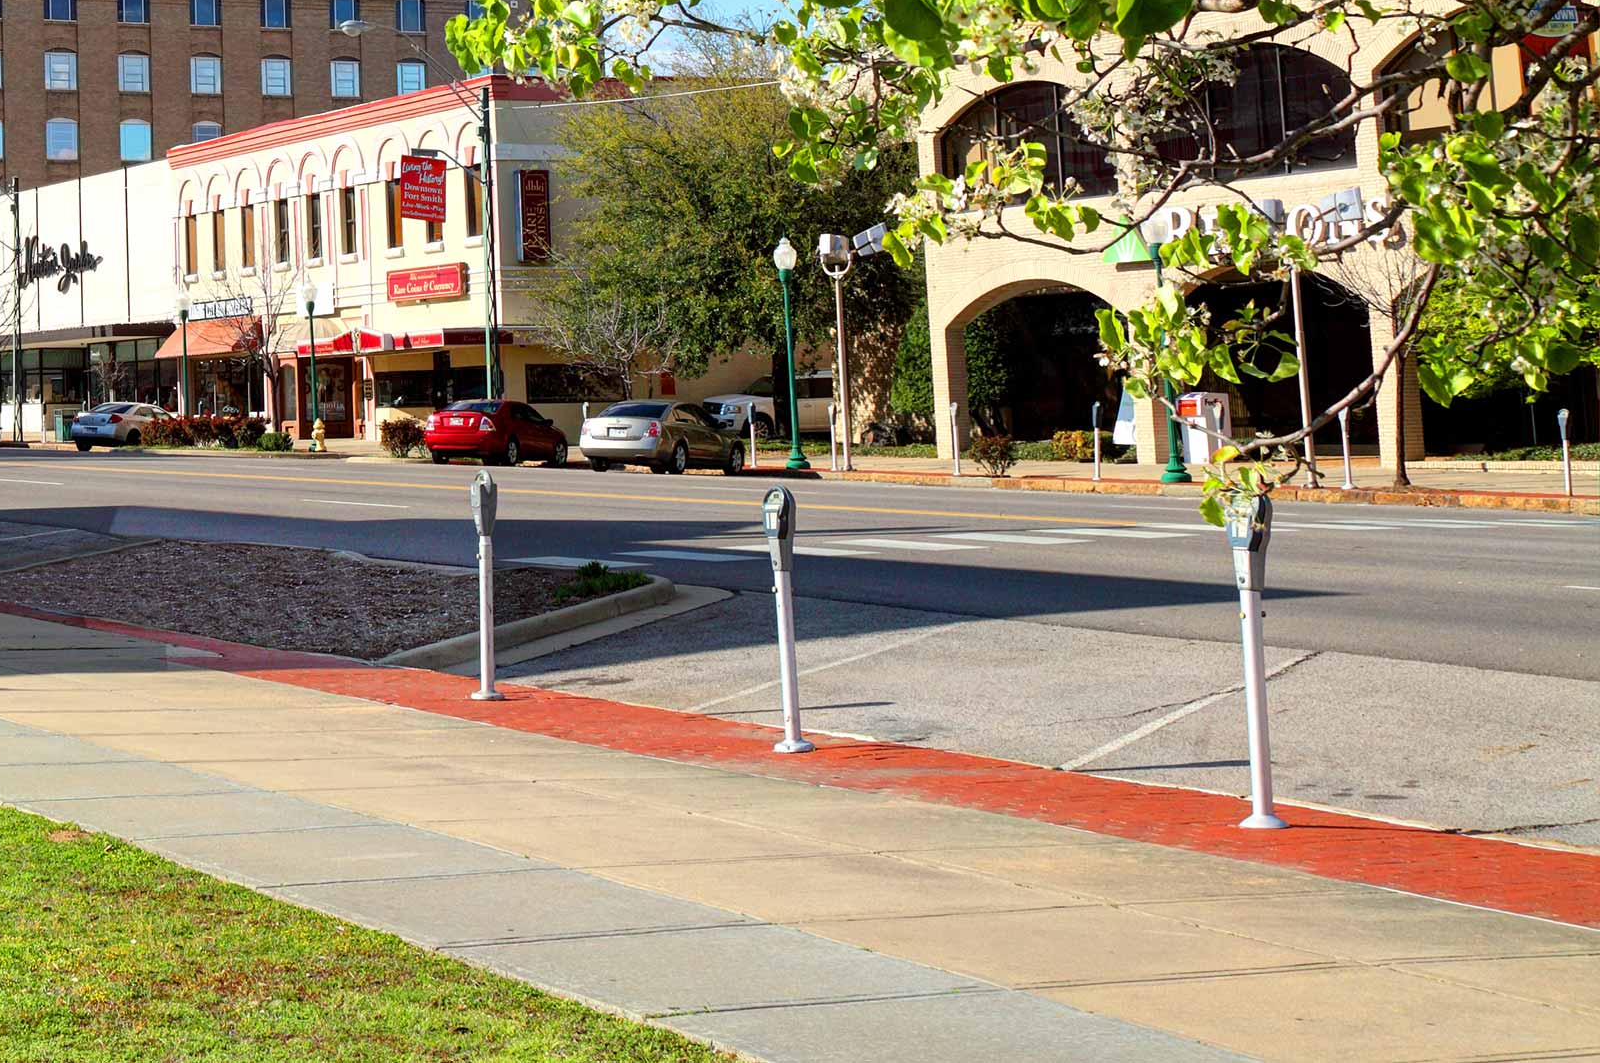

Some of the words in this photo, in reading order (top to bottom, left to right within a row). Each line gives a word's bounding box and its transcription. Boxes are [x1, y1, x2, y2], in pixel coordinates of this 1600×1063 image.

[402, 161, 421, 175] Living
[421, 160, 433, 171] the
[418, 169, 445, 186] History!
[404, 182, 443, 195] Downtown
[404, 191, 420, 201] Fort
[420, 193, 443, 203] Smith
[406, 282, 422, 294] Coins
[422, 281, 429, 292] &
